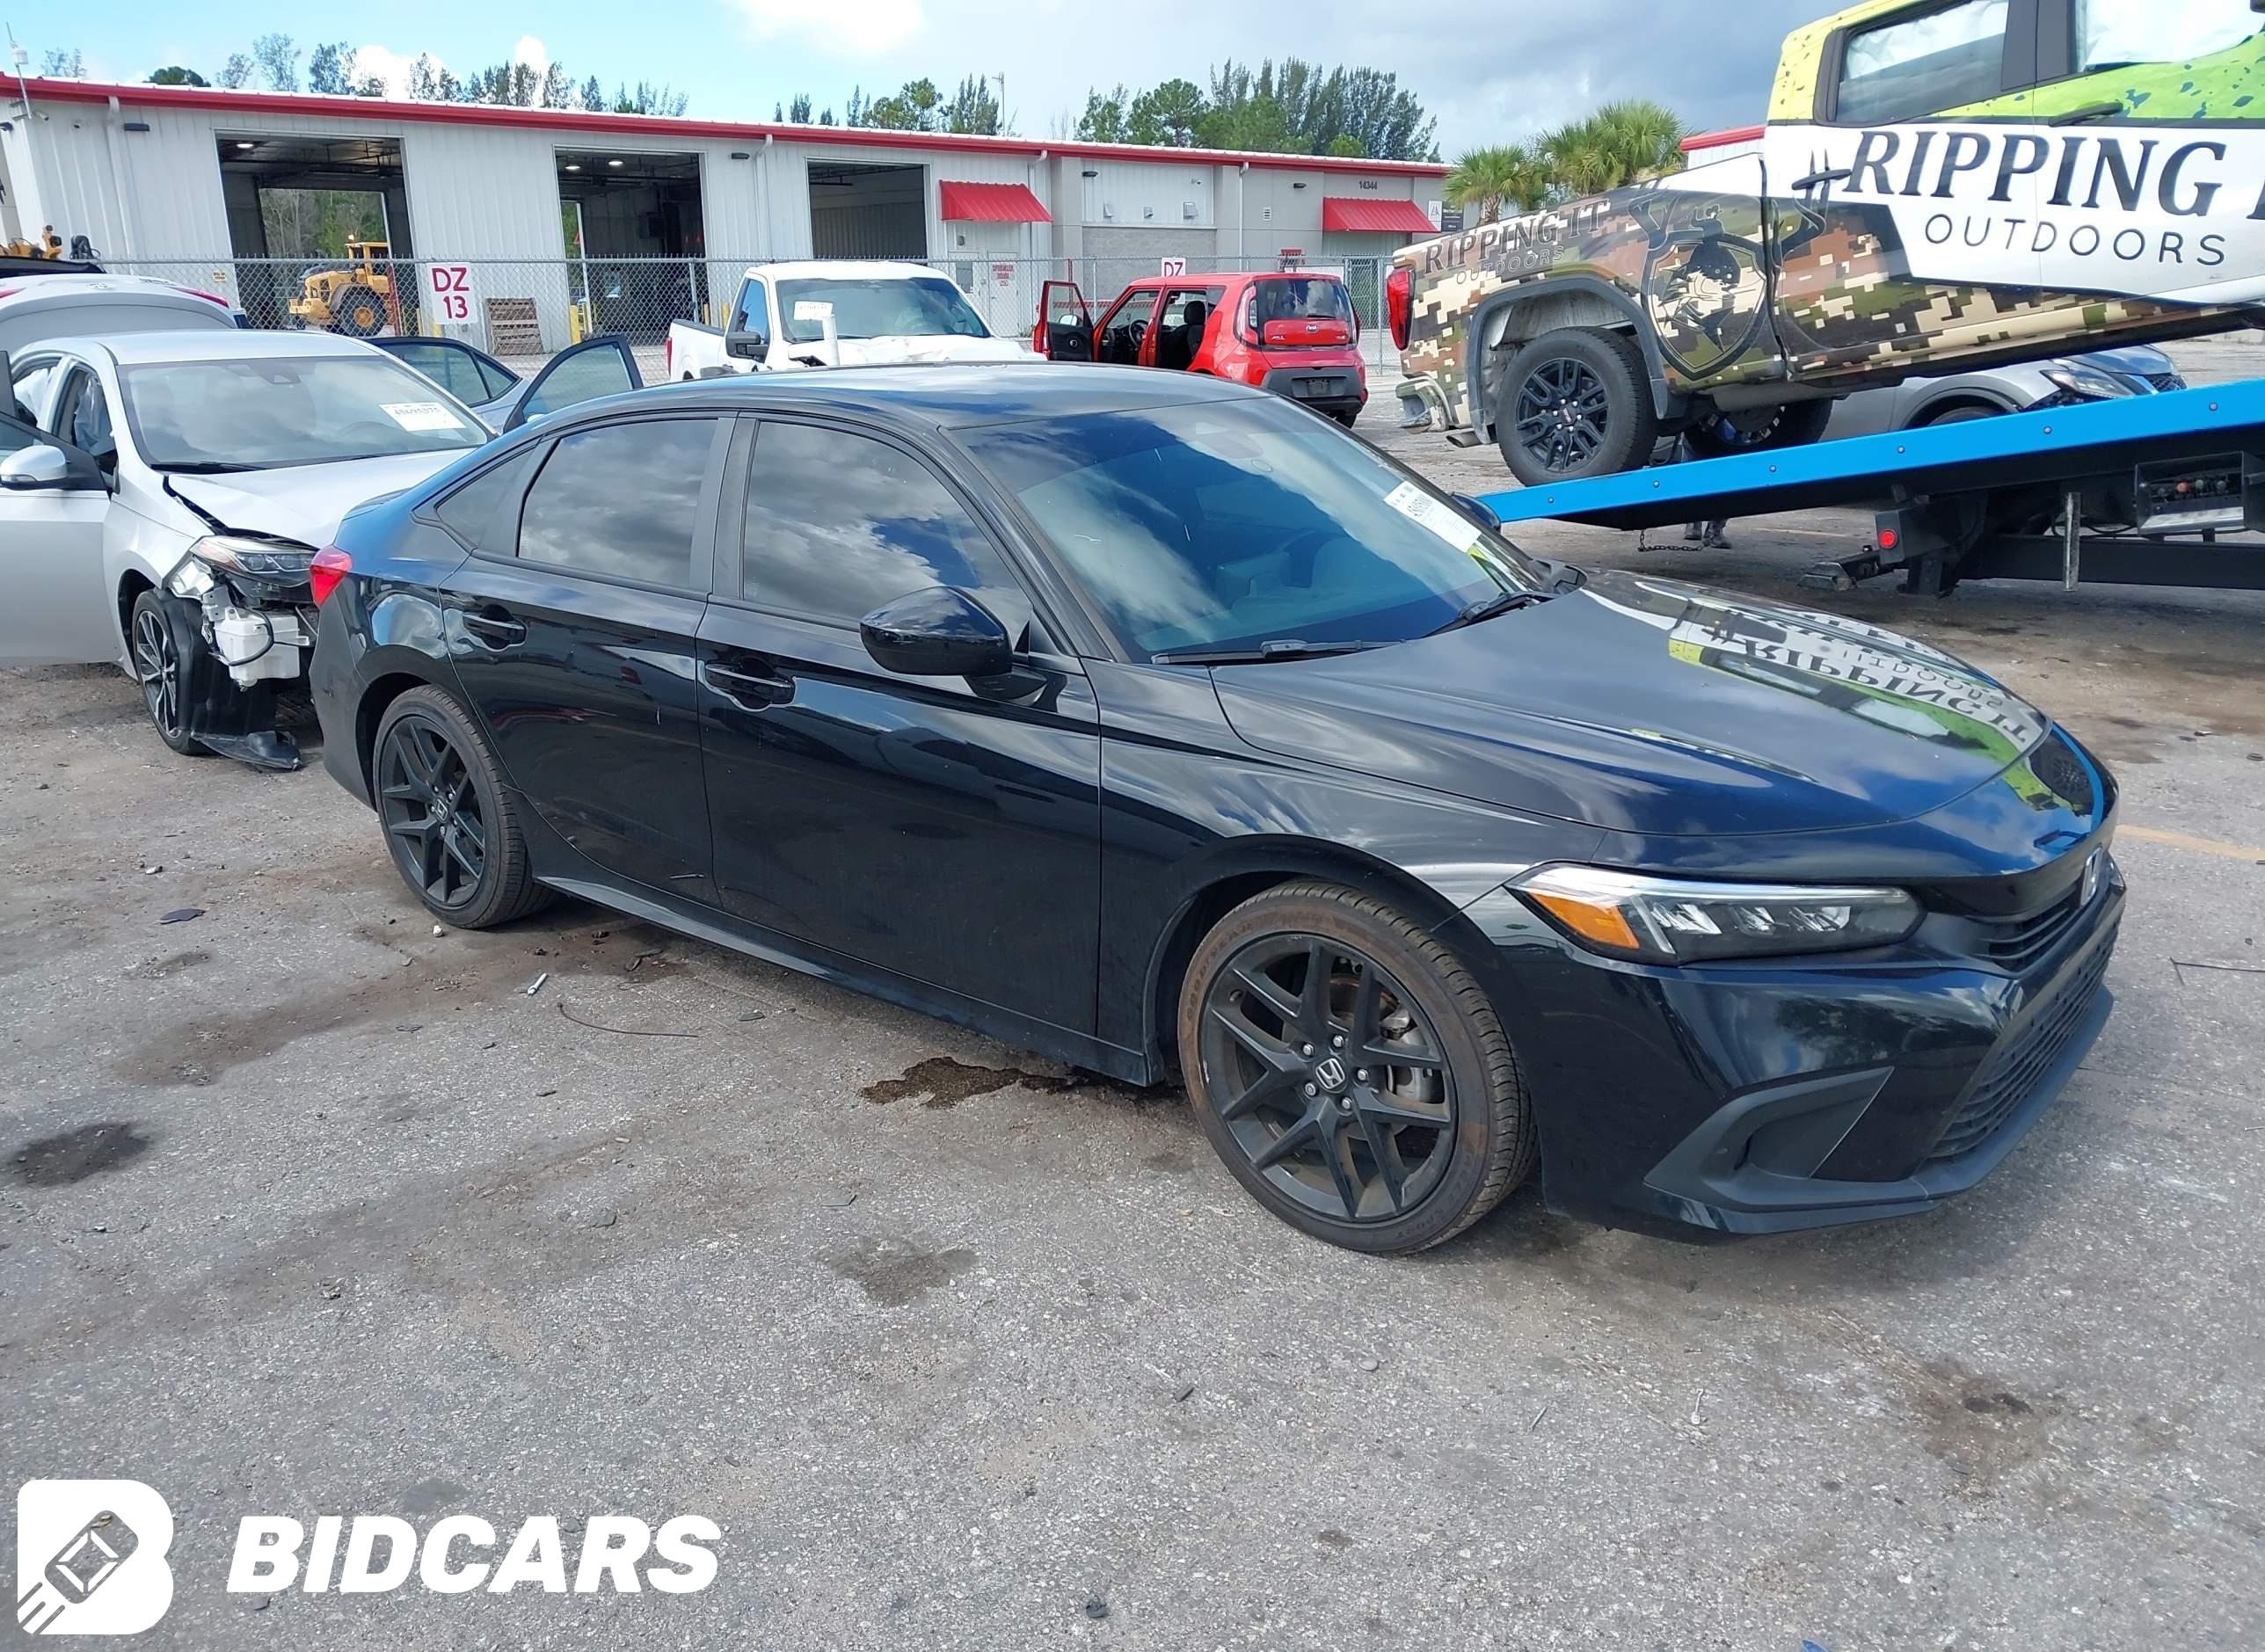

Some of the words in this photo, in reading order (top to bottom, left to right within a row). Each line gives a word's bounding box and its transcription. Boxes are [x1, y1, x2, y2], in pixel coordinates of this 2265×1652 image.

[1358, 180, 1378, 190] 14344
[1842, 131, 2226, 217] RIPPING
[1424, 210, 1561, 274] RIPPING
[1569, 198, 1610, 239] IT
[1926, 214, 2225, 266] OUTDOORS
[432, 267, 470, 291] DZ
[1164, 261, 1183, 276] DZ
[1456, 245, 1564, 285] OUTDOORS
[443, 295, 468, 318] 13
